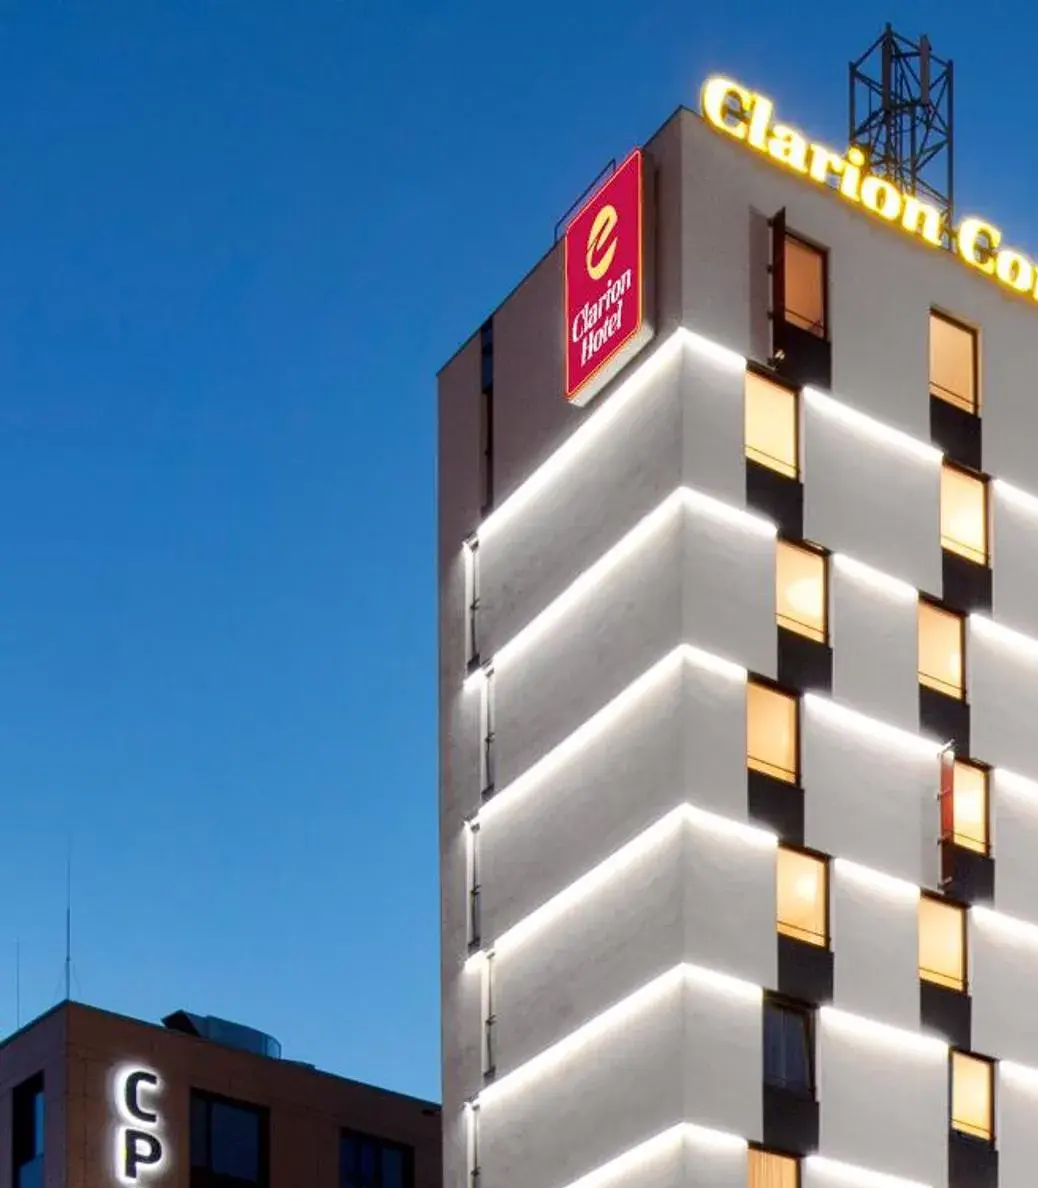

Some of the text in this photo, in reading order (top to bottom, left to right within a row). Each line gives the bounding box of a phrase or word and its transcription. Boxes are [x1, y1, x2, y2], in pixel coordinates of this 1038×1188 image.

[702, 76, 942, 247] Clarion
[573, 268, 632, 343] Clarion
[581, 300, 623, 367] Hotel
